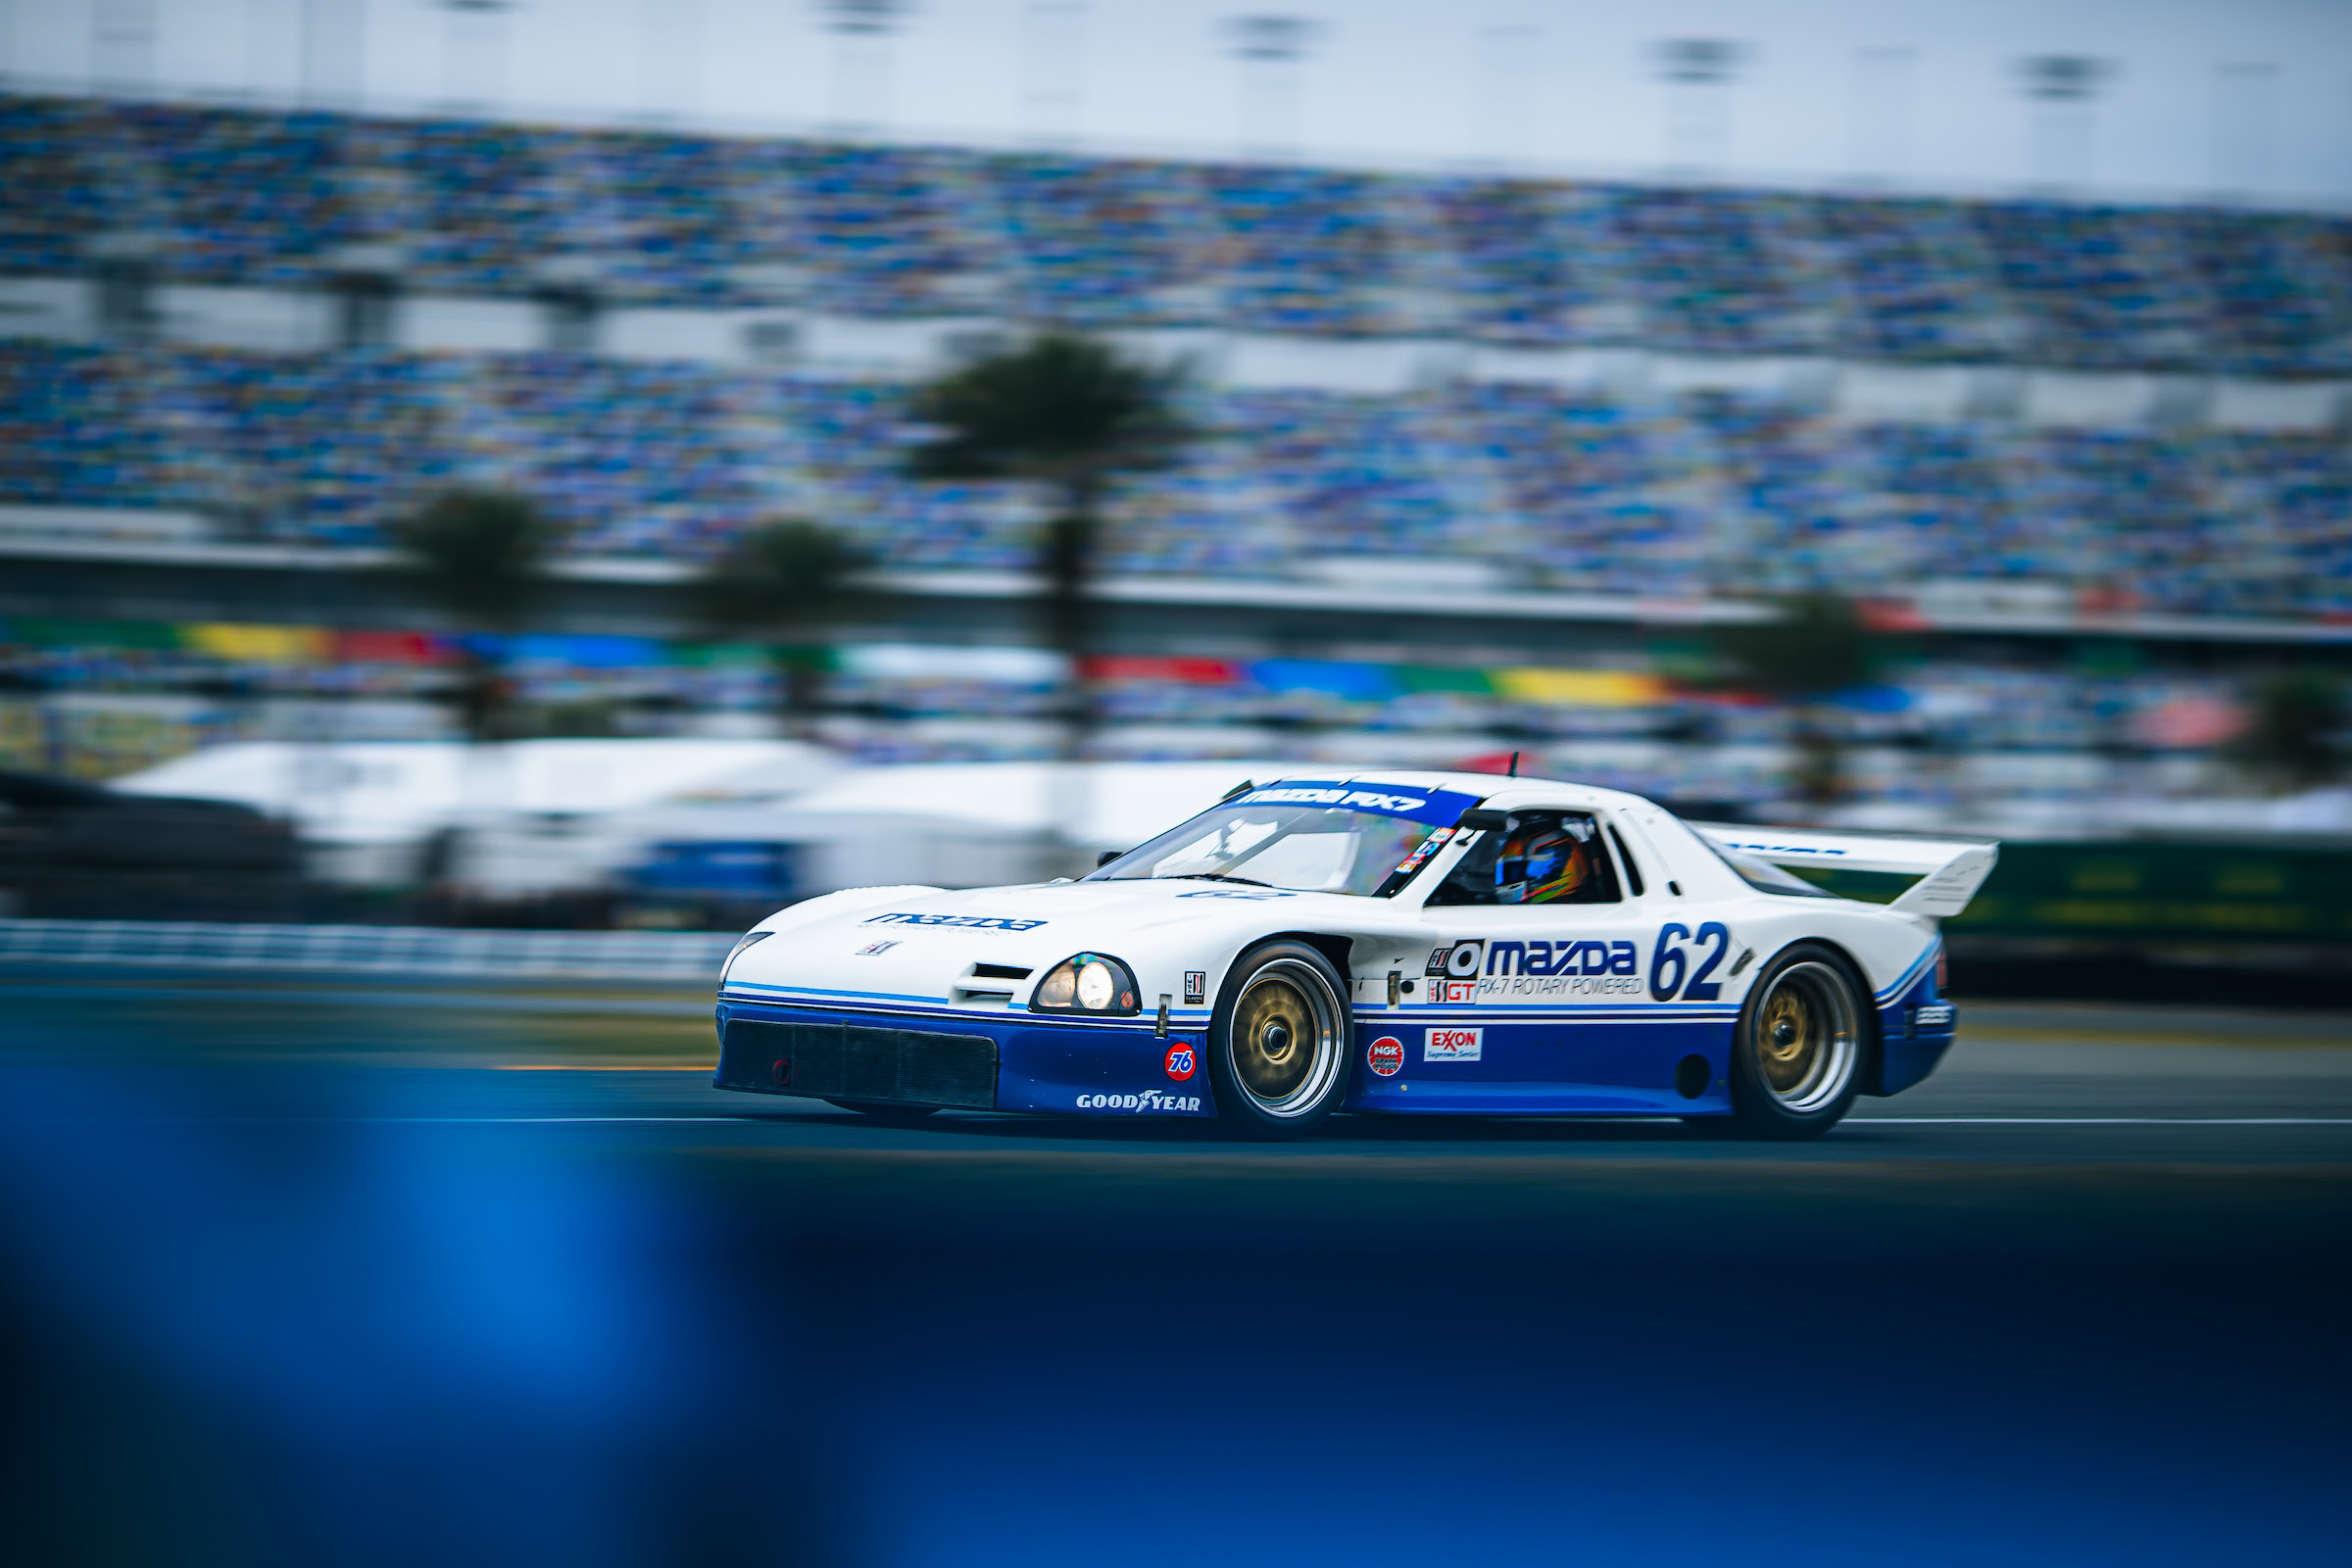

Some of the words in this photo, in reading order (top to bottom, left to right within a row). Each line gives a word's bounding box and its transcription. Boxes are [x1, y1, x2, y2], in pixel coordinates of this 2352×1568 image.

[1650, 921, 1729, 1002] 62
[1447, 983, 1476, 1001] GT
[1477, 978, 1510, 995] RX-7
[1510, 978, 1571, 995] ROTARY
[1570, 978, 1643, 995] POWERED
[1374, 1046, 1398, 1055] NGK
[1432, 1030, 1477, 1052] EXXON
[1168, 1051, 1193, 1073] 76
